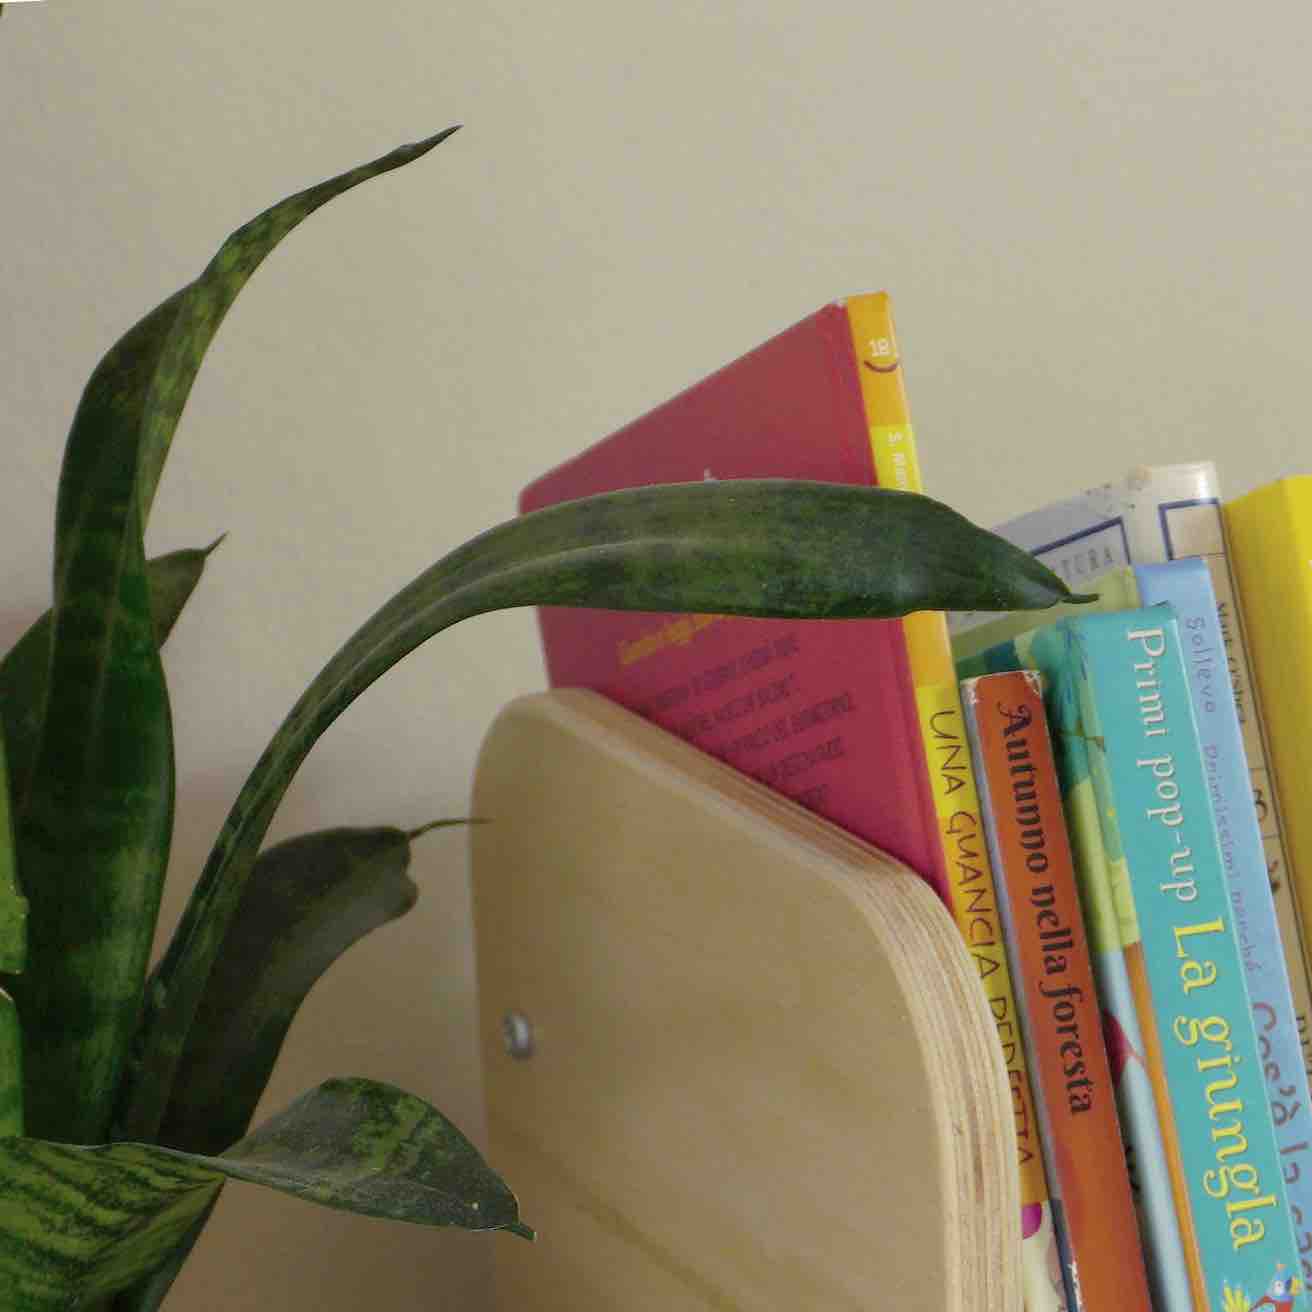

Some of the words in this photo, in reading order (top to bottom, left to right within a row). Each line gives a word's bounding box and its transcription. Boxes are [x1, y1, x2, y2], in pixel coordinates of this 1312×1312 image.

[1127, 626, 1169, 738] Primi
[930, 709, 966, 795] UNA
[949, 810, 1002, 979] GUANCIA
[996, 699, 1049, 874] Autunno
[1135, 752, 1198, 903] pop-up
[1031, 882, 1074, 976] nella
[1172, 917, 1226, 994] La
[1039, 981, 1096, 1115] foresta
[1172, 1014, 1279, 1252] giungla
